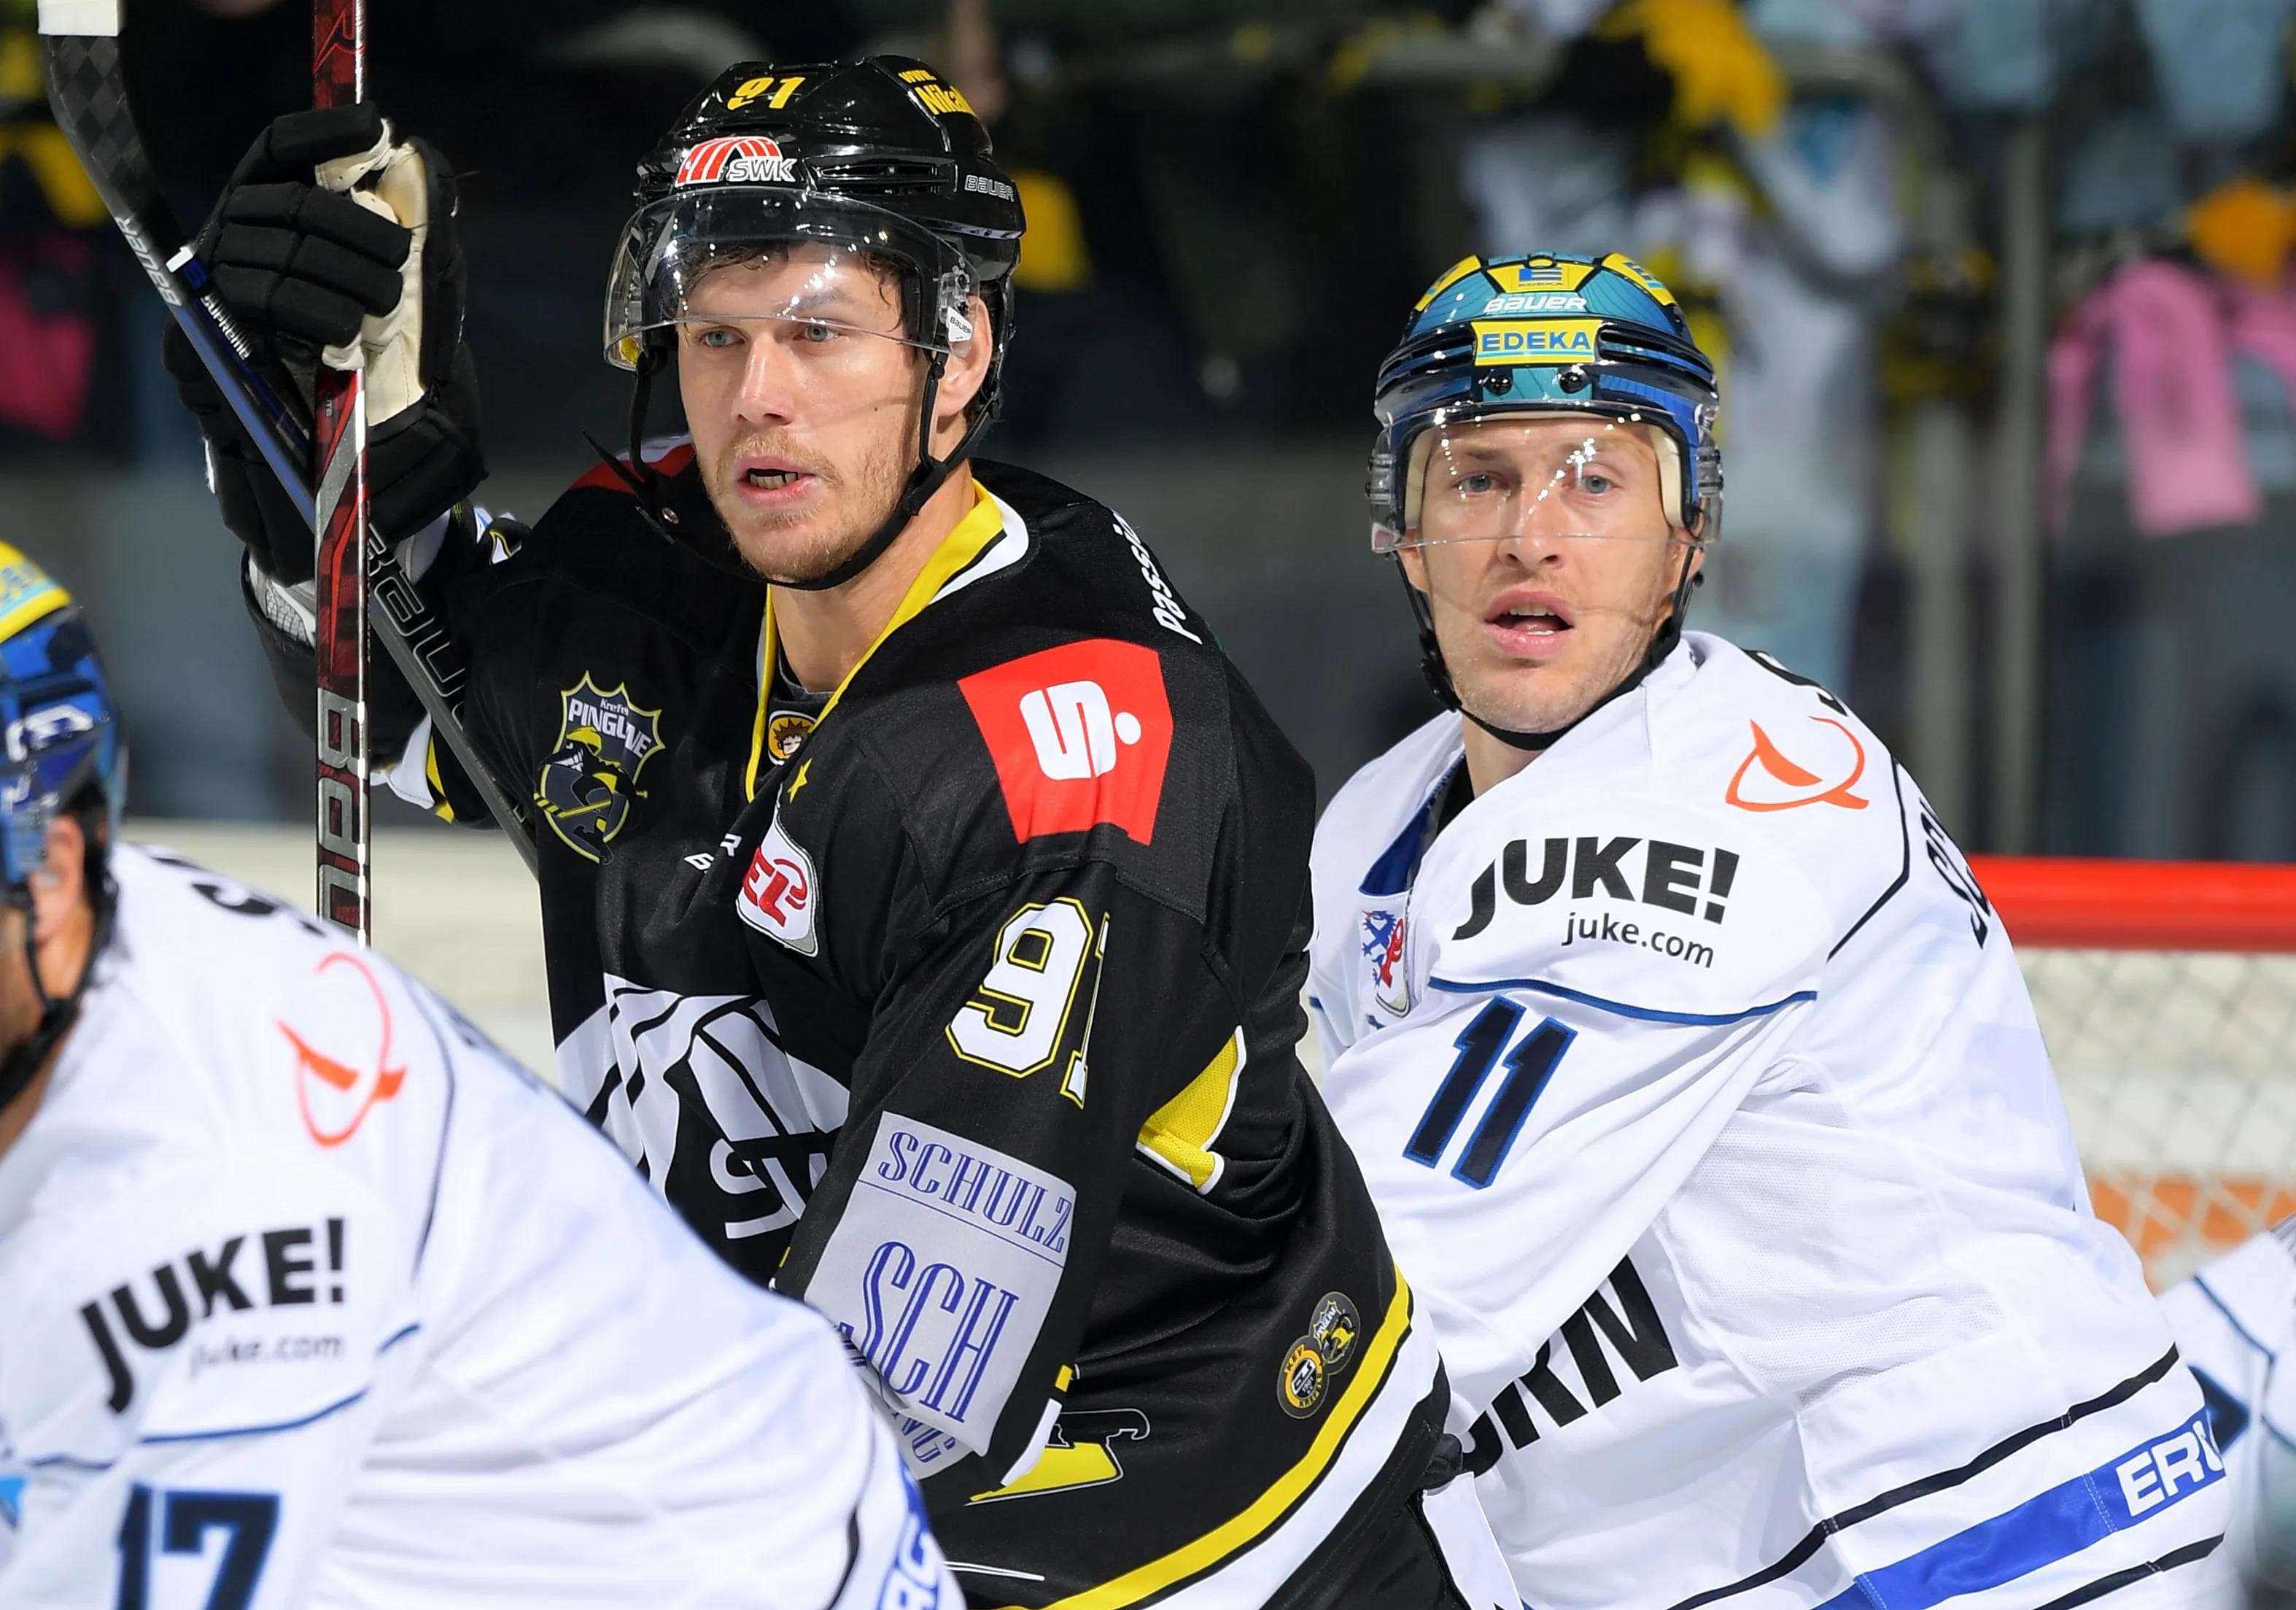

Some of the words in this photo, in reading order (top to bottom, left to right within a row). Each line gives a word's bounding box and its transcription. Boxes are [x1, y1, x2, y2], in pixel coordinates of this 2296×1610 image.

[727, 77, 806, 111] 91
[726, 158, 797, 182] SWK
[964, 174, 1015, 203] BAUER
[1484, 295, 1587, 314] BAUER
[1481, 331, 1591, 352] EDEKA
[1451, 836, 1740, 940] JUKE!
[1561, 911, 1715, 969] juke.com
[1402, 995, 1579, 1190] 11
[878, 1131, 1072, 1254] SCHULZ
[79, 1218, 346, 1415] JUKE!
[189, 1331, 344, 1379] juke.com
[115, 1480, 282, 1610] 17
